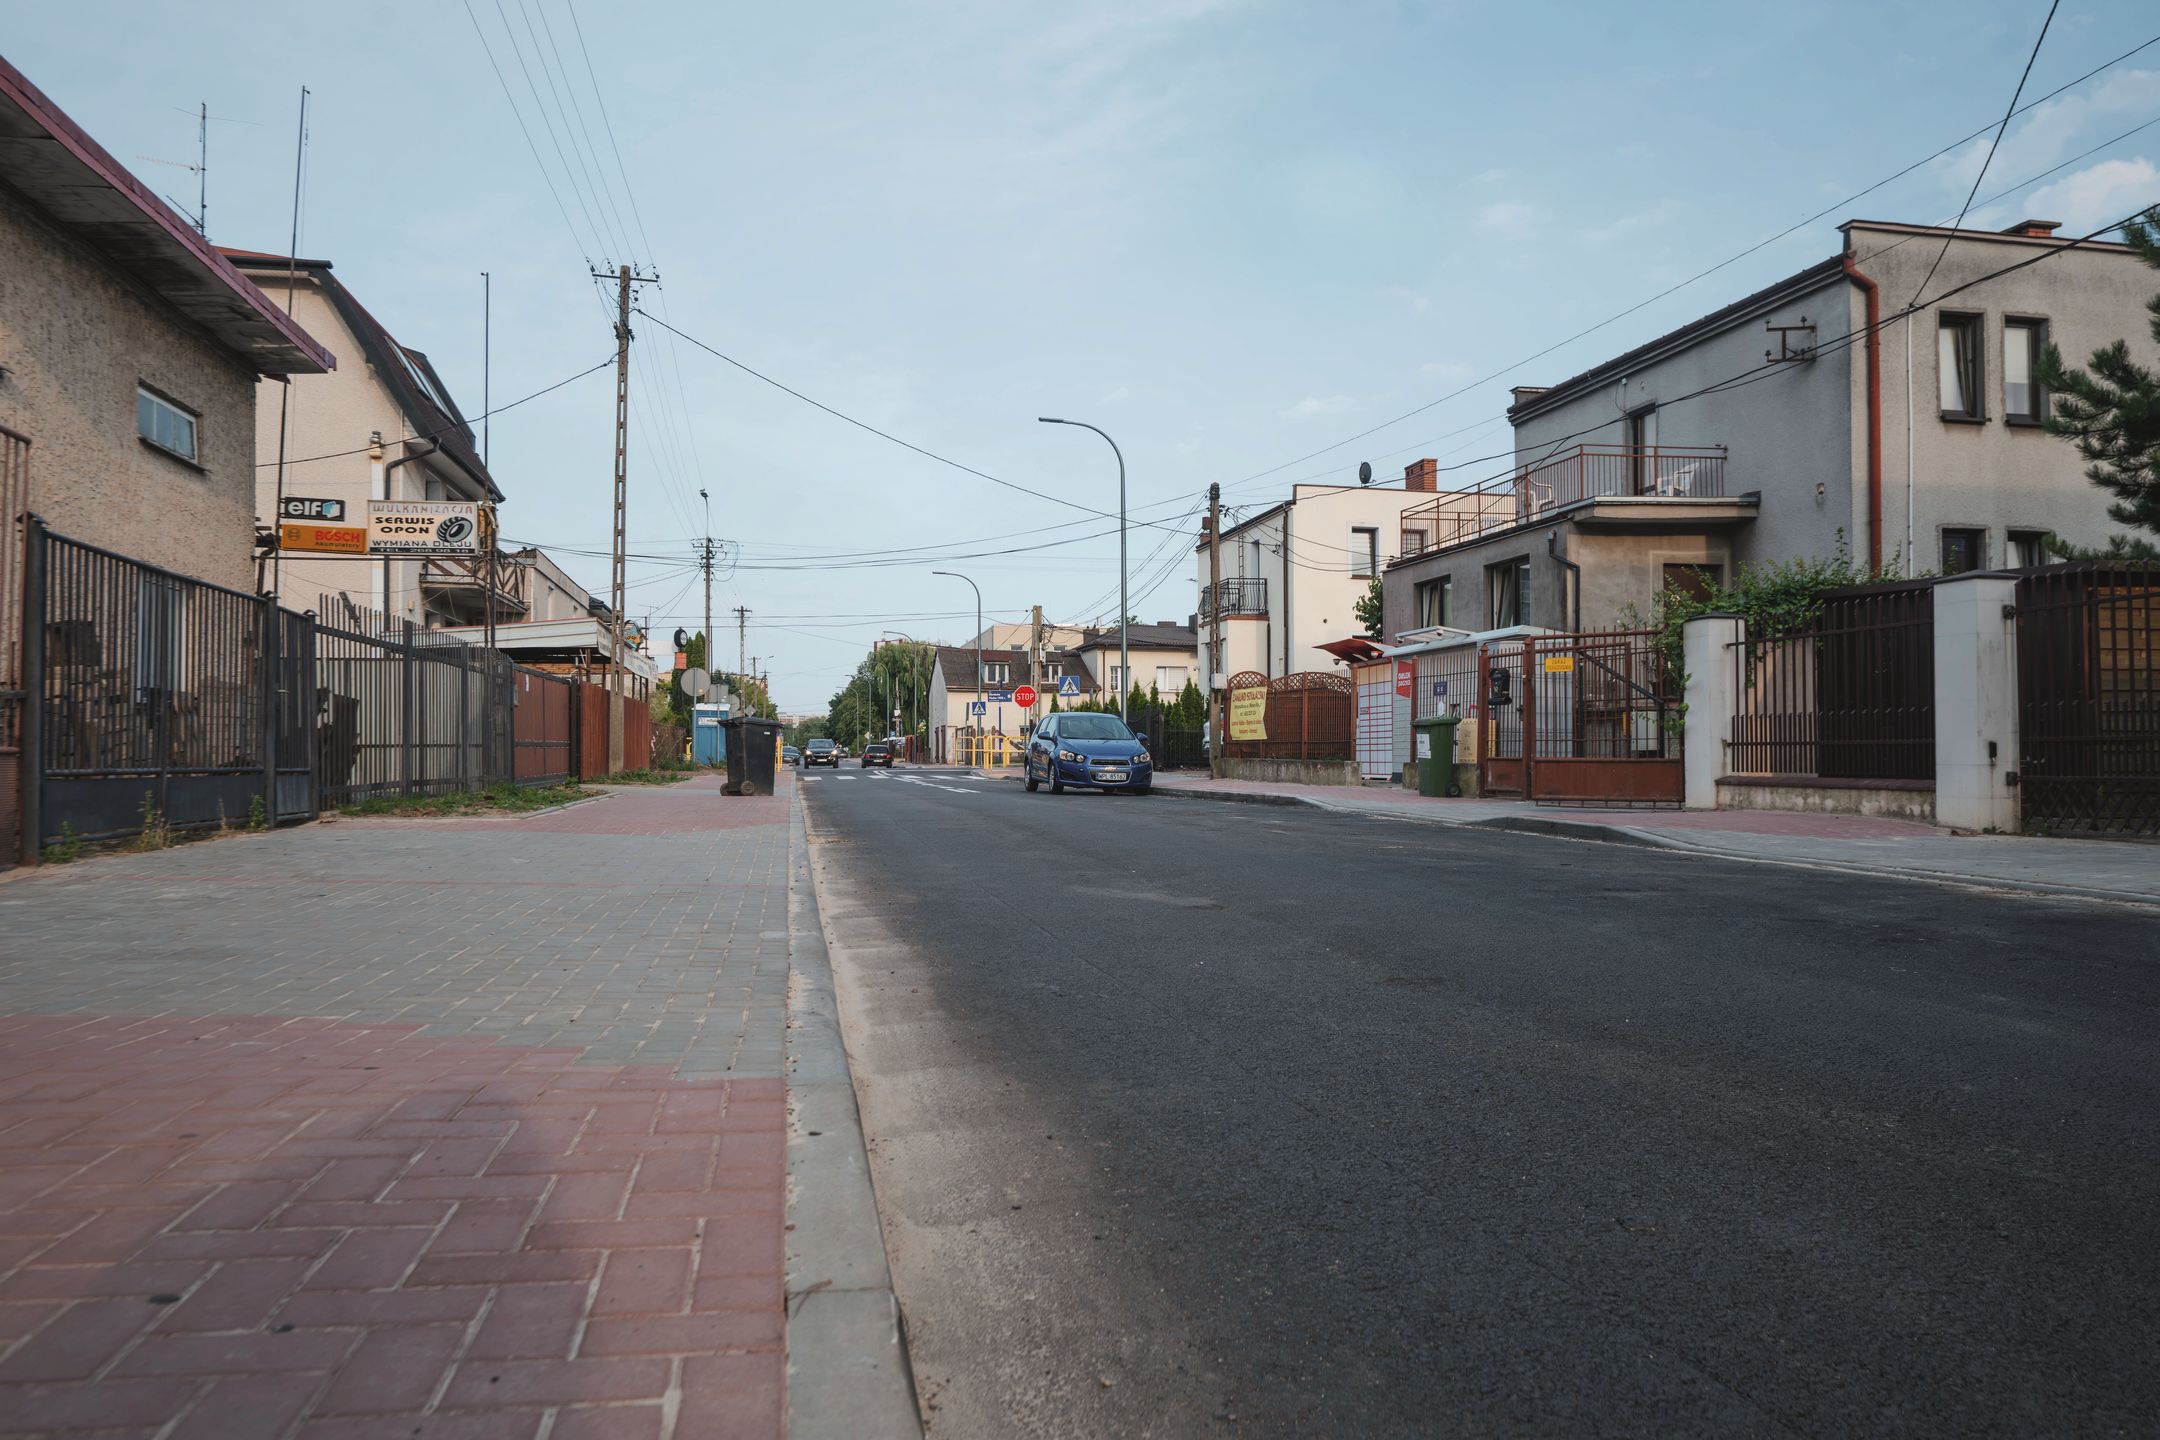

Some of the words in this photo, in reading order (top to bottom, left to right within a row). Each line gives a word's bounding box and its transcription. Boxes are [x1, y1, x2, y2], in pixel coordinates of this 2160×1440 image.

[288, 501, 322, 516] elf
[373, 504, 473, 514] WULKANIZACJA
[375, 517, 435, 525] SERWIS
[380, 526, 430, 534] OPON
[314, 530, 360, 543] BOSCH
[1016, 693, 1035, 701] STOP
